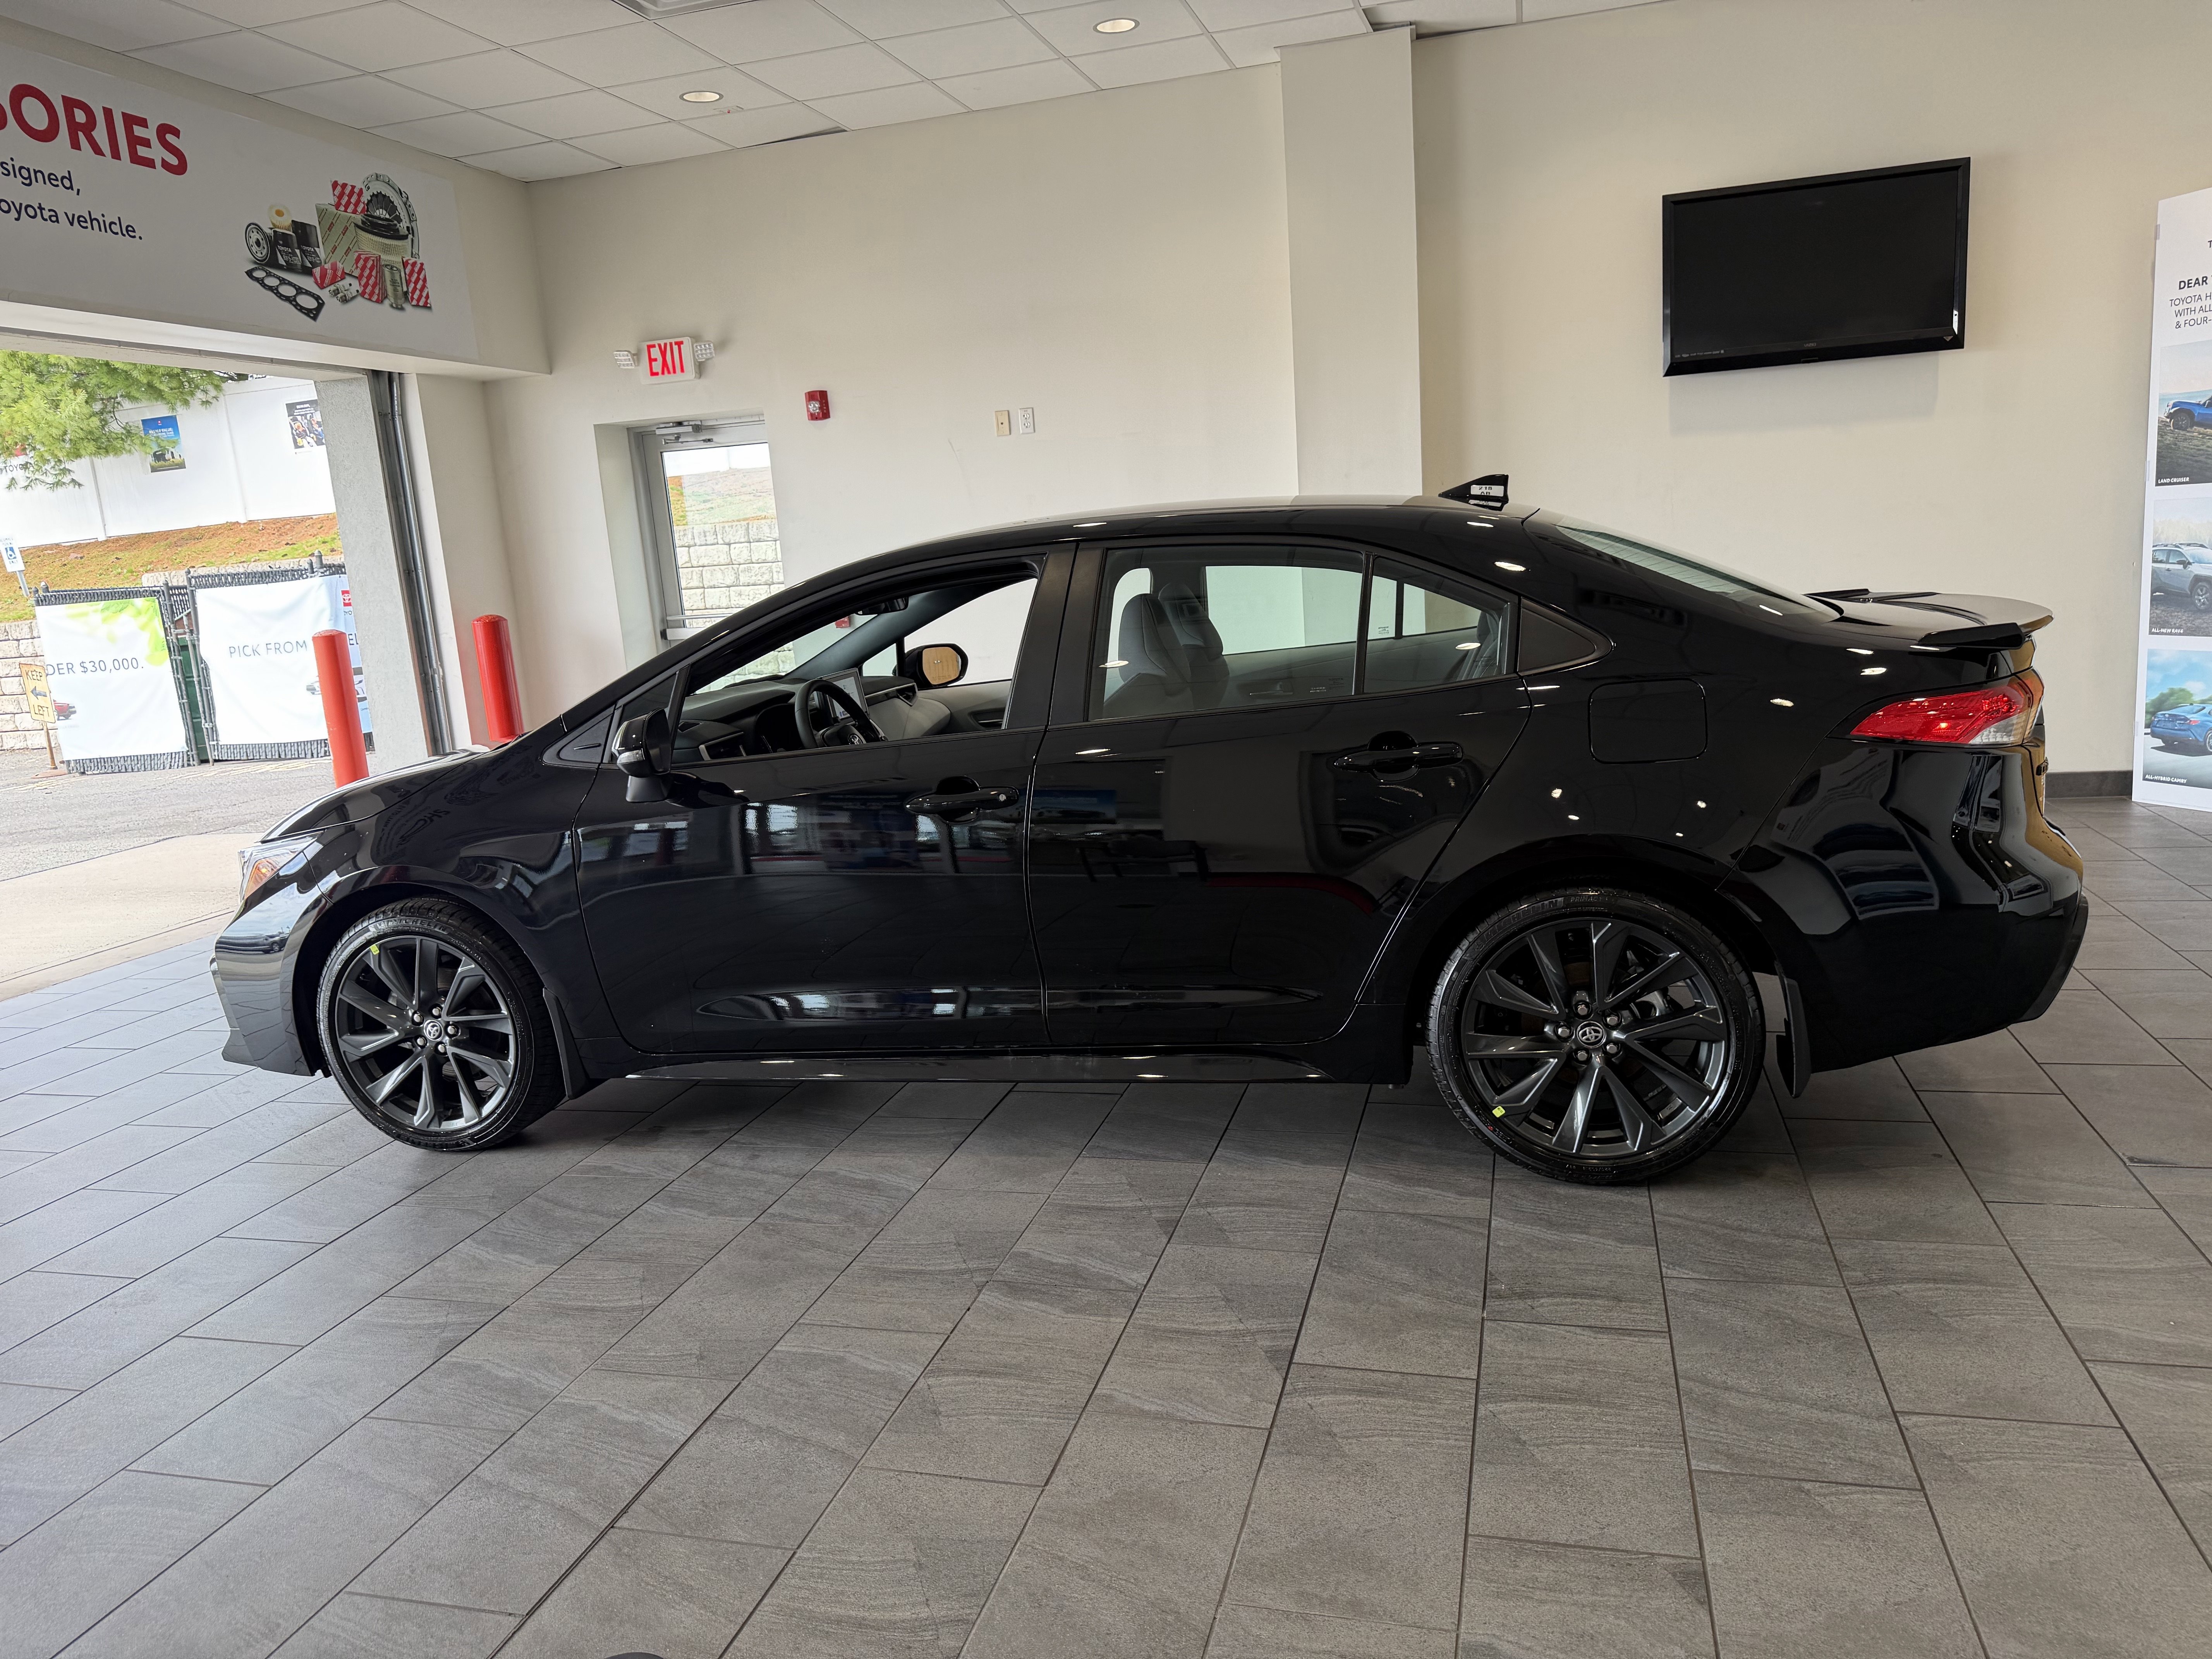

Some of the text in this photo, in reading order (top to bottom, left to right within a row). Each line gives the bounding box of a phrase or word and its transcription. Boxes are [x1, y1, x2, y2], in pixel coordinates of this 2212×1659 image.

[0, 84, 188, 176] ORIES
[0, 157, 81, 196] signed,
[0, 198, 143, 240] oyota vehicle.
[2178, 275, 2208, 290] DEAR
[2169, 294, 2202, 307] TOYOTA
[2174, 306, 2196, 318] WITH
[646, 340, 685, 376] EXIT
[229, 644, 261, 658] PICK
[266, 640, 307, 655] FROM
[80, 657, 144, 673] $30,000.
[25, 669, 43, 682] KEEP
[33, 704, 50, 717] LEFT
